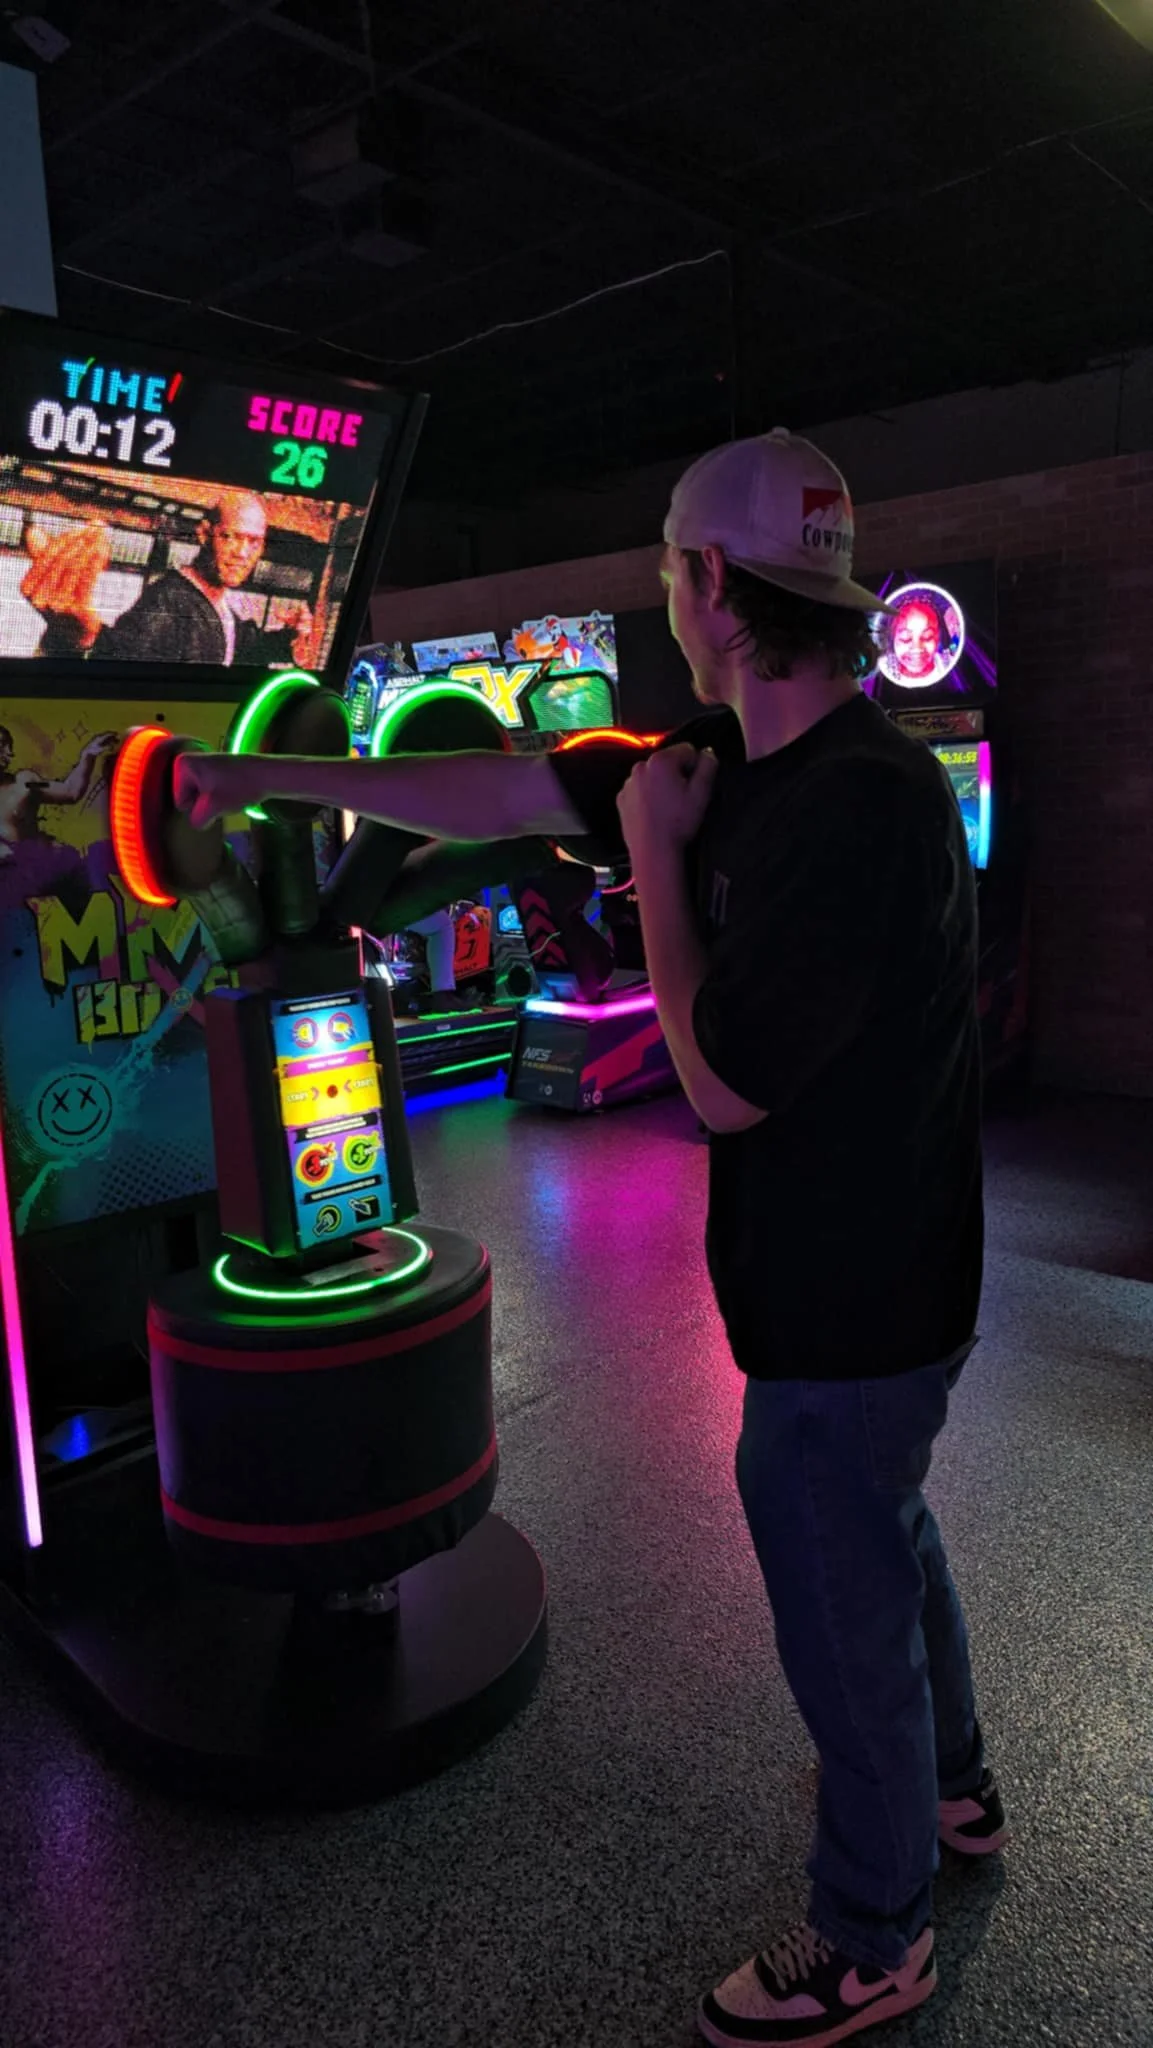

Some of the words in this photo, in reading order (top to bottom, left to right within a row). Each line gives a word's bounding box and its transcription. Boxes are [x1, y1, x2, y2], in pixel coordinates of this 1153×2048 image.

[62, 359, 167, 412] TIME
[28, 400, 176, 468] 00:12
[247, 396, 363, 447] SCORE
[270, 441, 329, 489] 26
